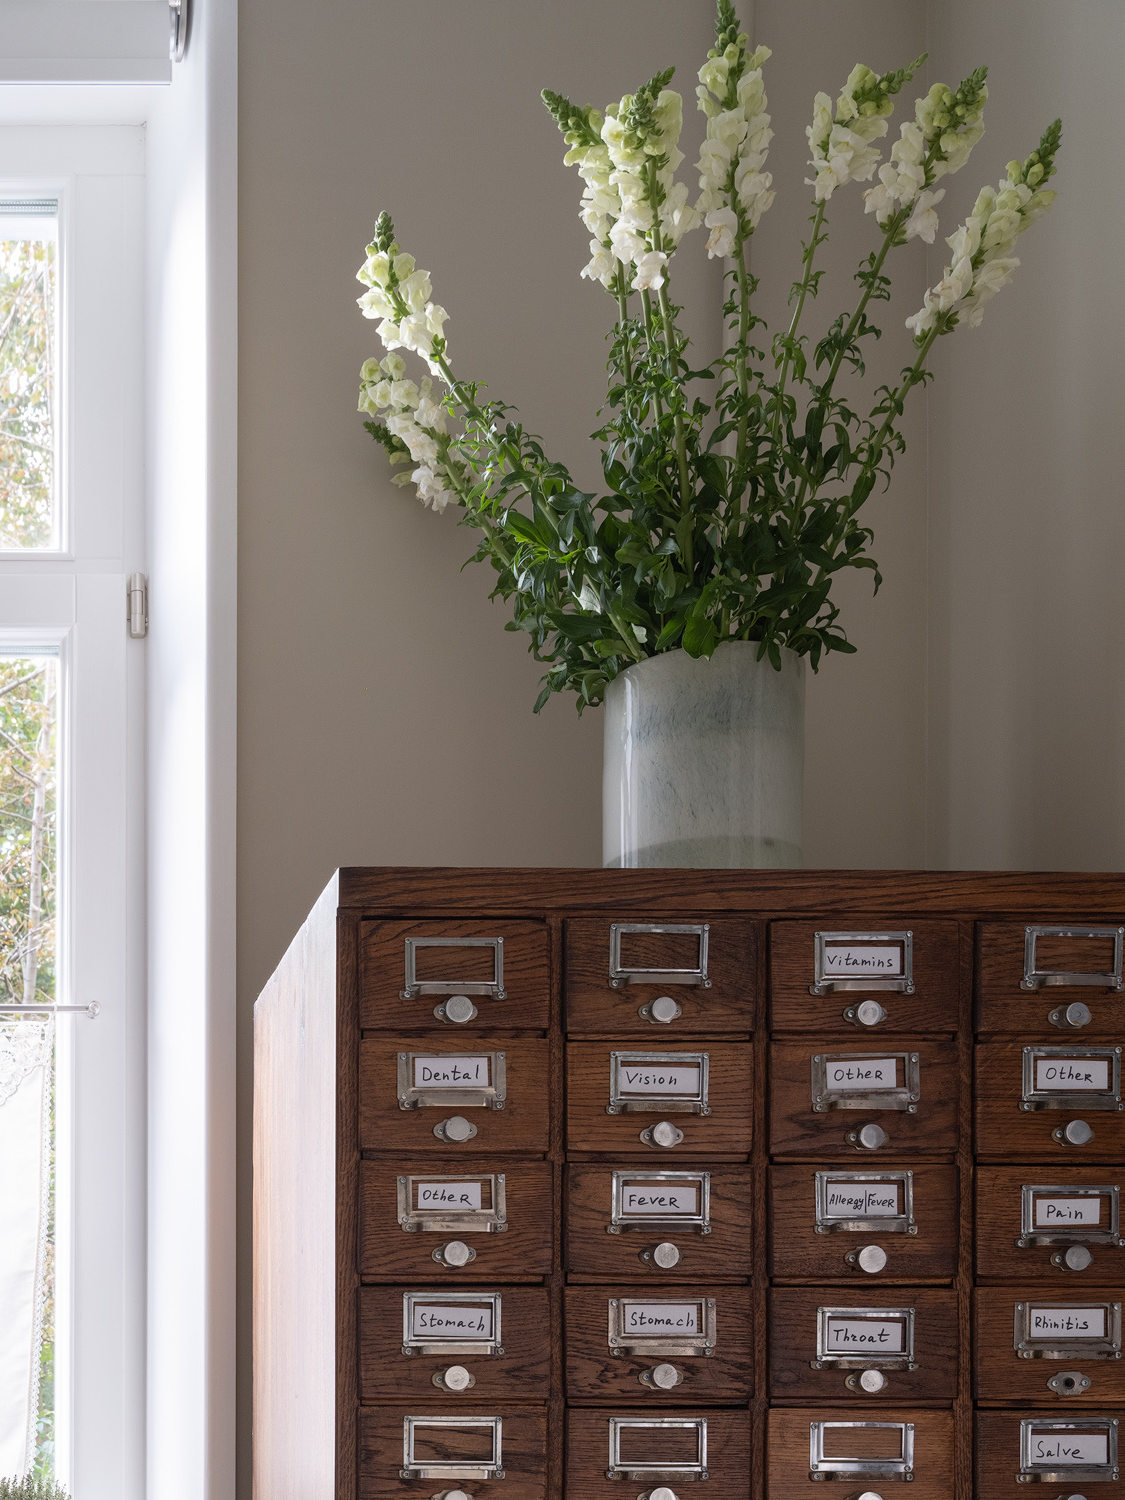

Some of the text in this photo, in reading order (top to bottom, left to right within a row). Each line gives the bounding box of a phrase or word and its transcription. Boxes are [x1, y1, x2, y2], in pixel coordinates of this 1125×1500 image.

[826, 952, 893, 968] Vitamins
[422, 1064, 480, 1082] Dental
[625, 1070, 677, 1085] Vision
[1046, 1204, 1083, 1219] Pain
[419, 1312, 485, 1331] Stomach
[630, 1311, 694, 1327] Stomach
[1034, 1316, 1089, 1330] Rhinitis
[833, 1327, 890, 1343] Throat
[1035, 1441, 1084, 1459] Salve
